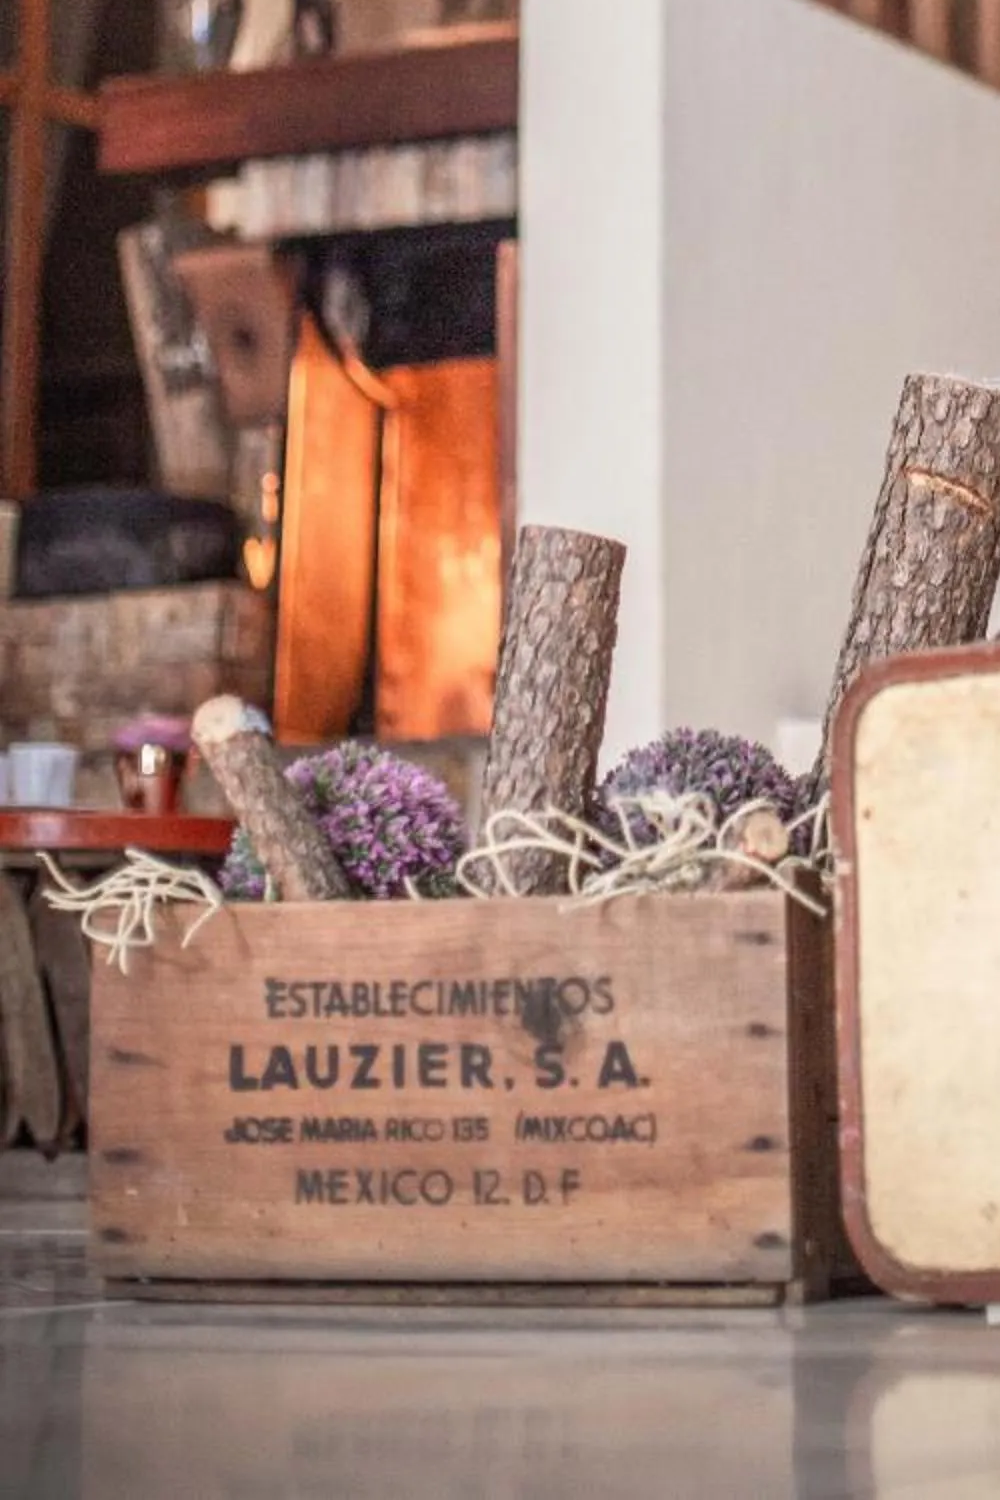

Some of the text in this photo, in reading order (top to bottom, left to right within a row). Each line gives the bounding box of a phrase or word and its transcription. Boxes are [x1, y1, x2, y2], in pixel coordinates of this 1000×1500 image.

[264, 976, 615, 1018] ESTABLECIMIENTOS
[533, 1045, 579, 1089] S.
[597, 1040, 651, 1090] A.
[224, 1110, 657, 1144] JOSE MARIA RICO 135 (MIXCOAC)
[295, 1168, 454, 1205] MEXICO
